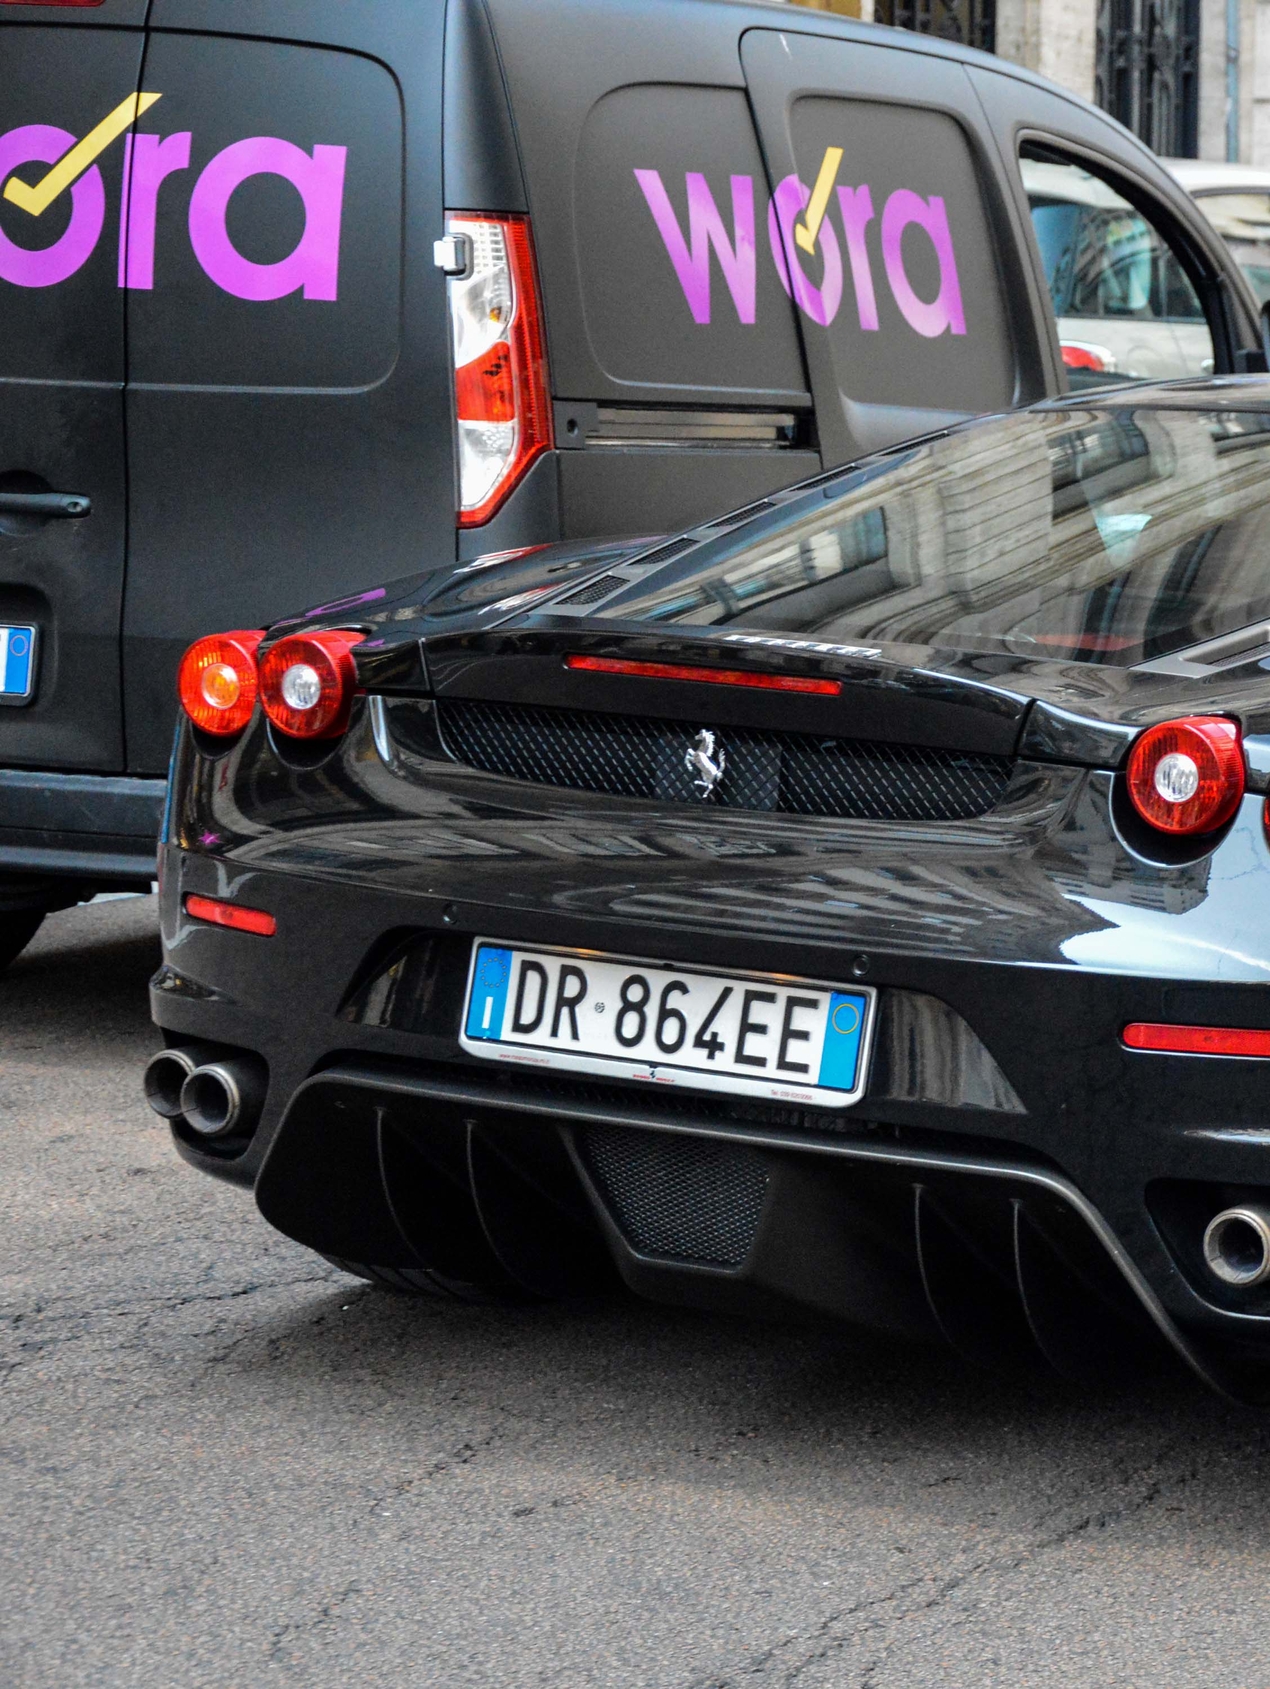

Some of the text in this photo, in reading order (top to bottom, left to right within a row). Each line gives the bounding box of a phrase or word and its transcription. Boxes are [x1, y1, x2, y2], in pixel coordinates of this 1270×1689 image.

[634, 168, 966, 338] wora
[511, 959, 820, 1075] DR 864EE
